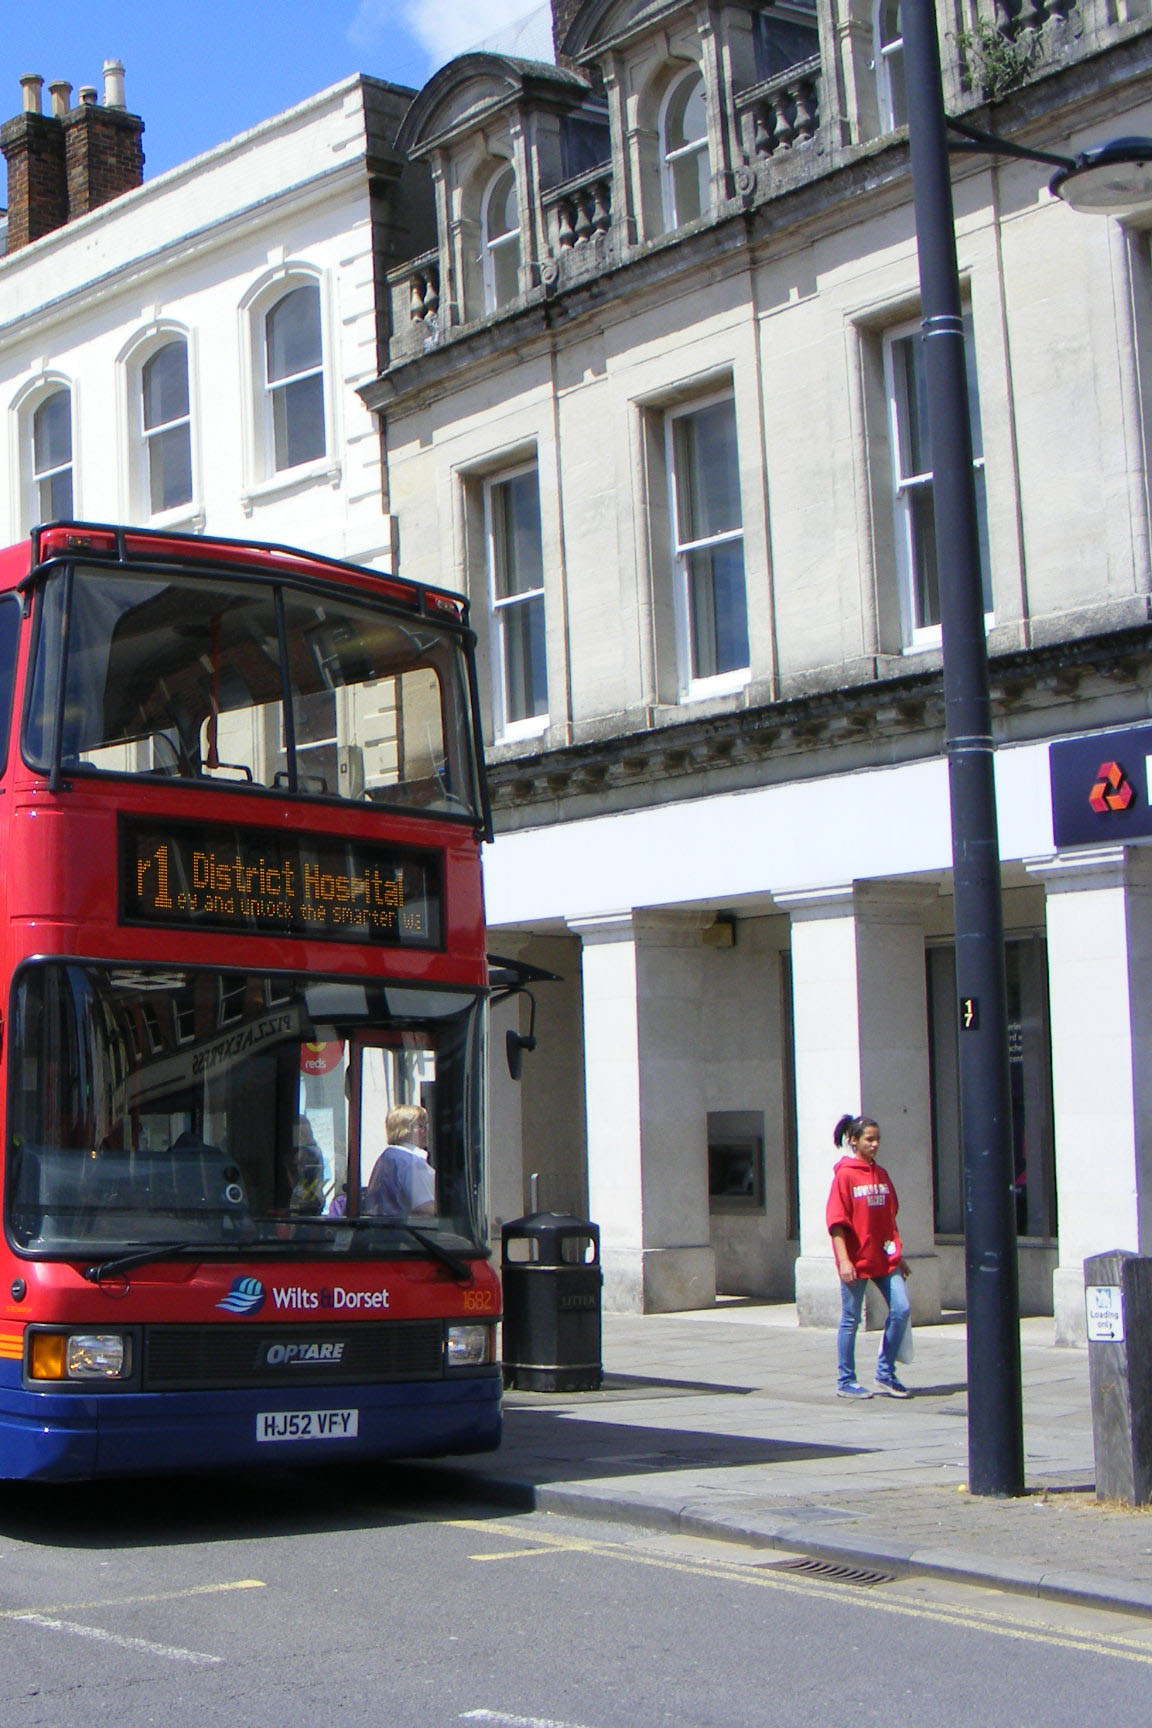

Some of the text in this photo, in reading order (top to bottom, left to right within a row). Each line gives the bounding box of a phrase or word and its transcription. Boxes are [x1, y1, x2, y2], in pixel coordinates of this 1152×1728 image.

[193, 852, 295, 897] District
[304, 863, 404, 907] Hospital
[205, 895, 234, 914] and
[300, 904, 326, 921] the
[333, 906, 397, 927] smarter
[272, 1287, 319, 1309] Wilts
[333, 1287, 390, 1309] Dorset
[463, 1290, 492, 1310] 1682
[1090, 1311, 1119, 1320] Loading
[266, 1342, 345, 1364] OPTARE
[263, 1411, 351, 1437] HJ52 VFY
